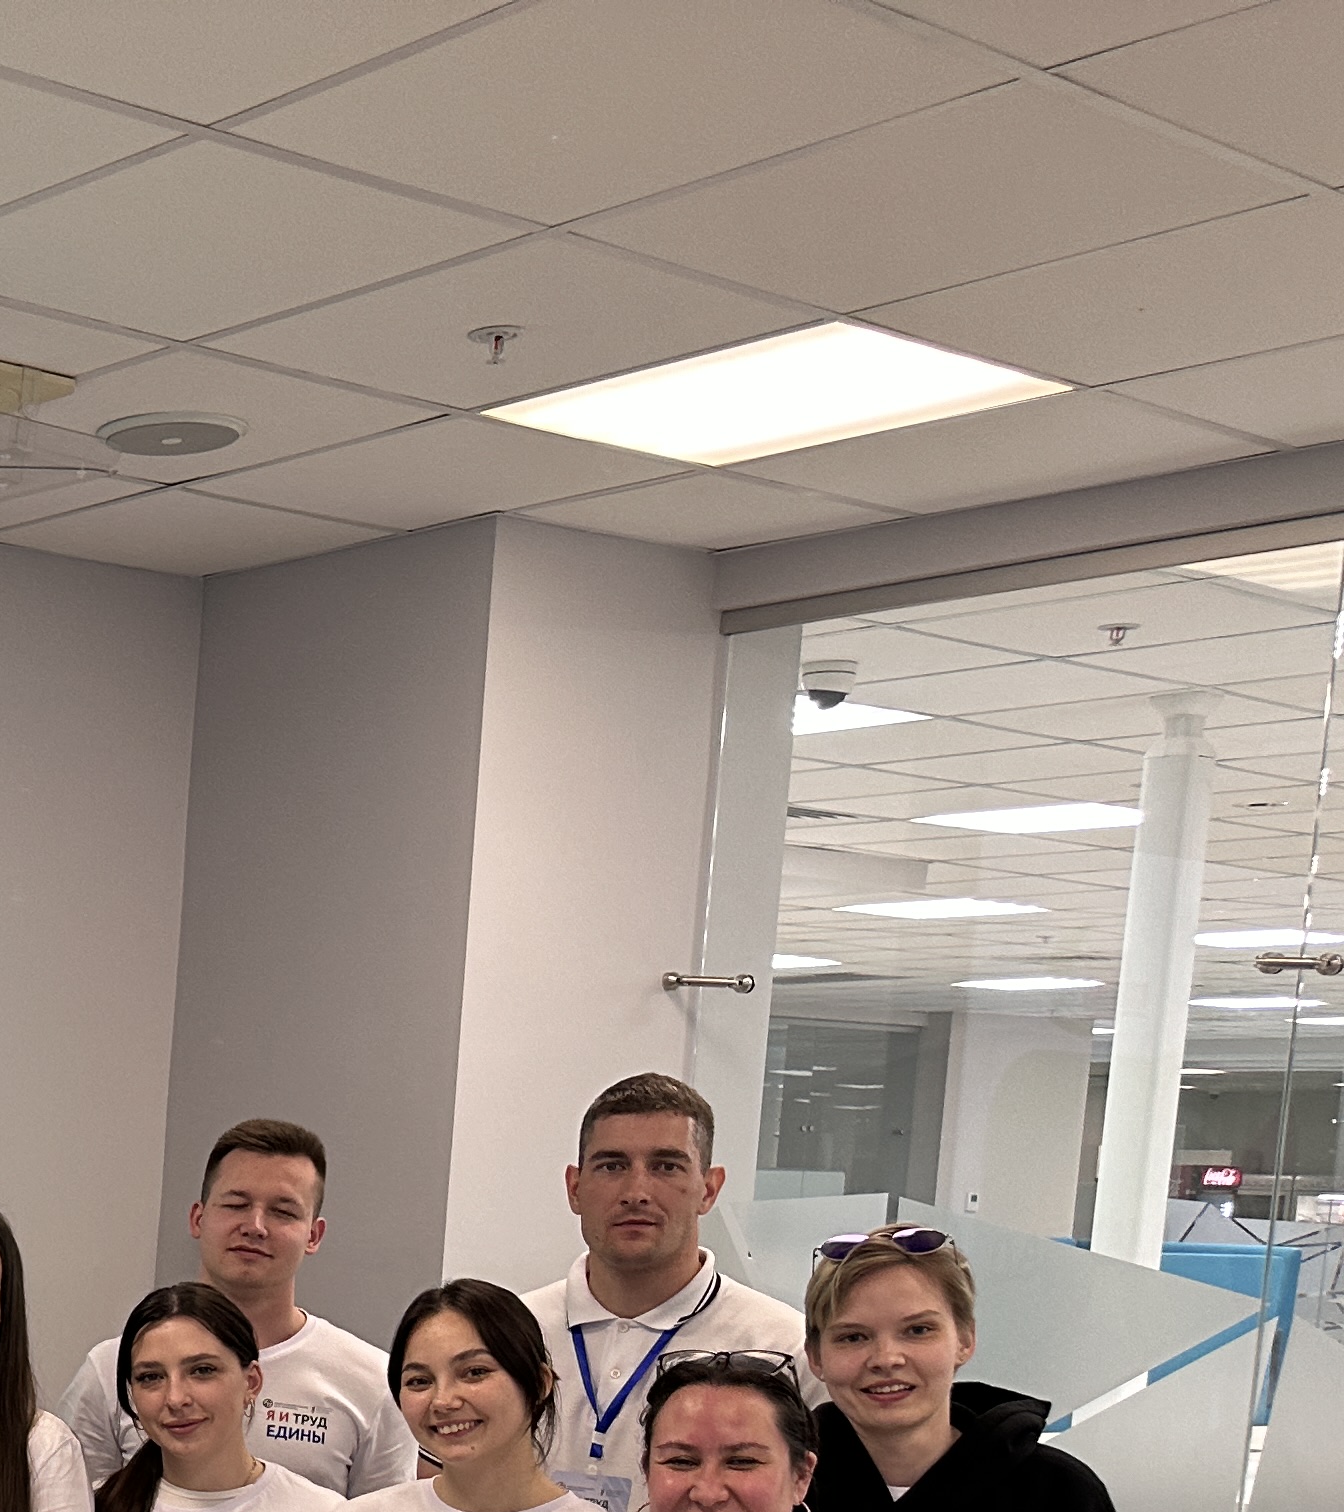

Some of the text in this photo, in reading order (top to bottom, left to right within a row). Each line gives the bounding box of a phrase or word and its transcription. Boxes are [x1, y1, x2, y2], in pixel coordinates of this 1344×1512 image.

[266, 1409, 328, 1430] Я И ТРУД
[265, 1424, 326, 1445] ЕДИНЫ
